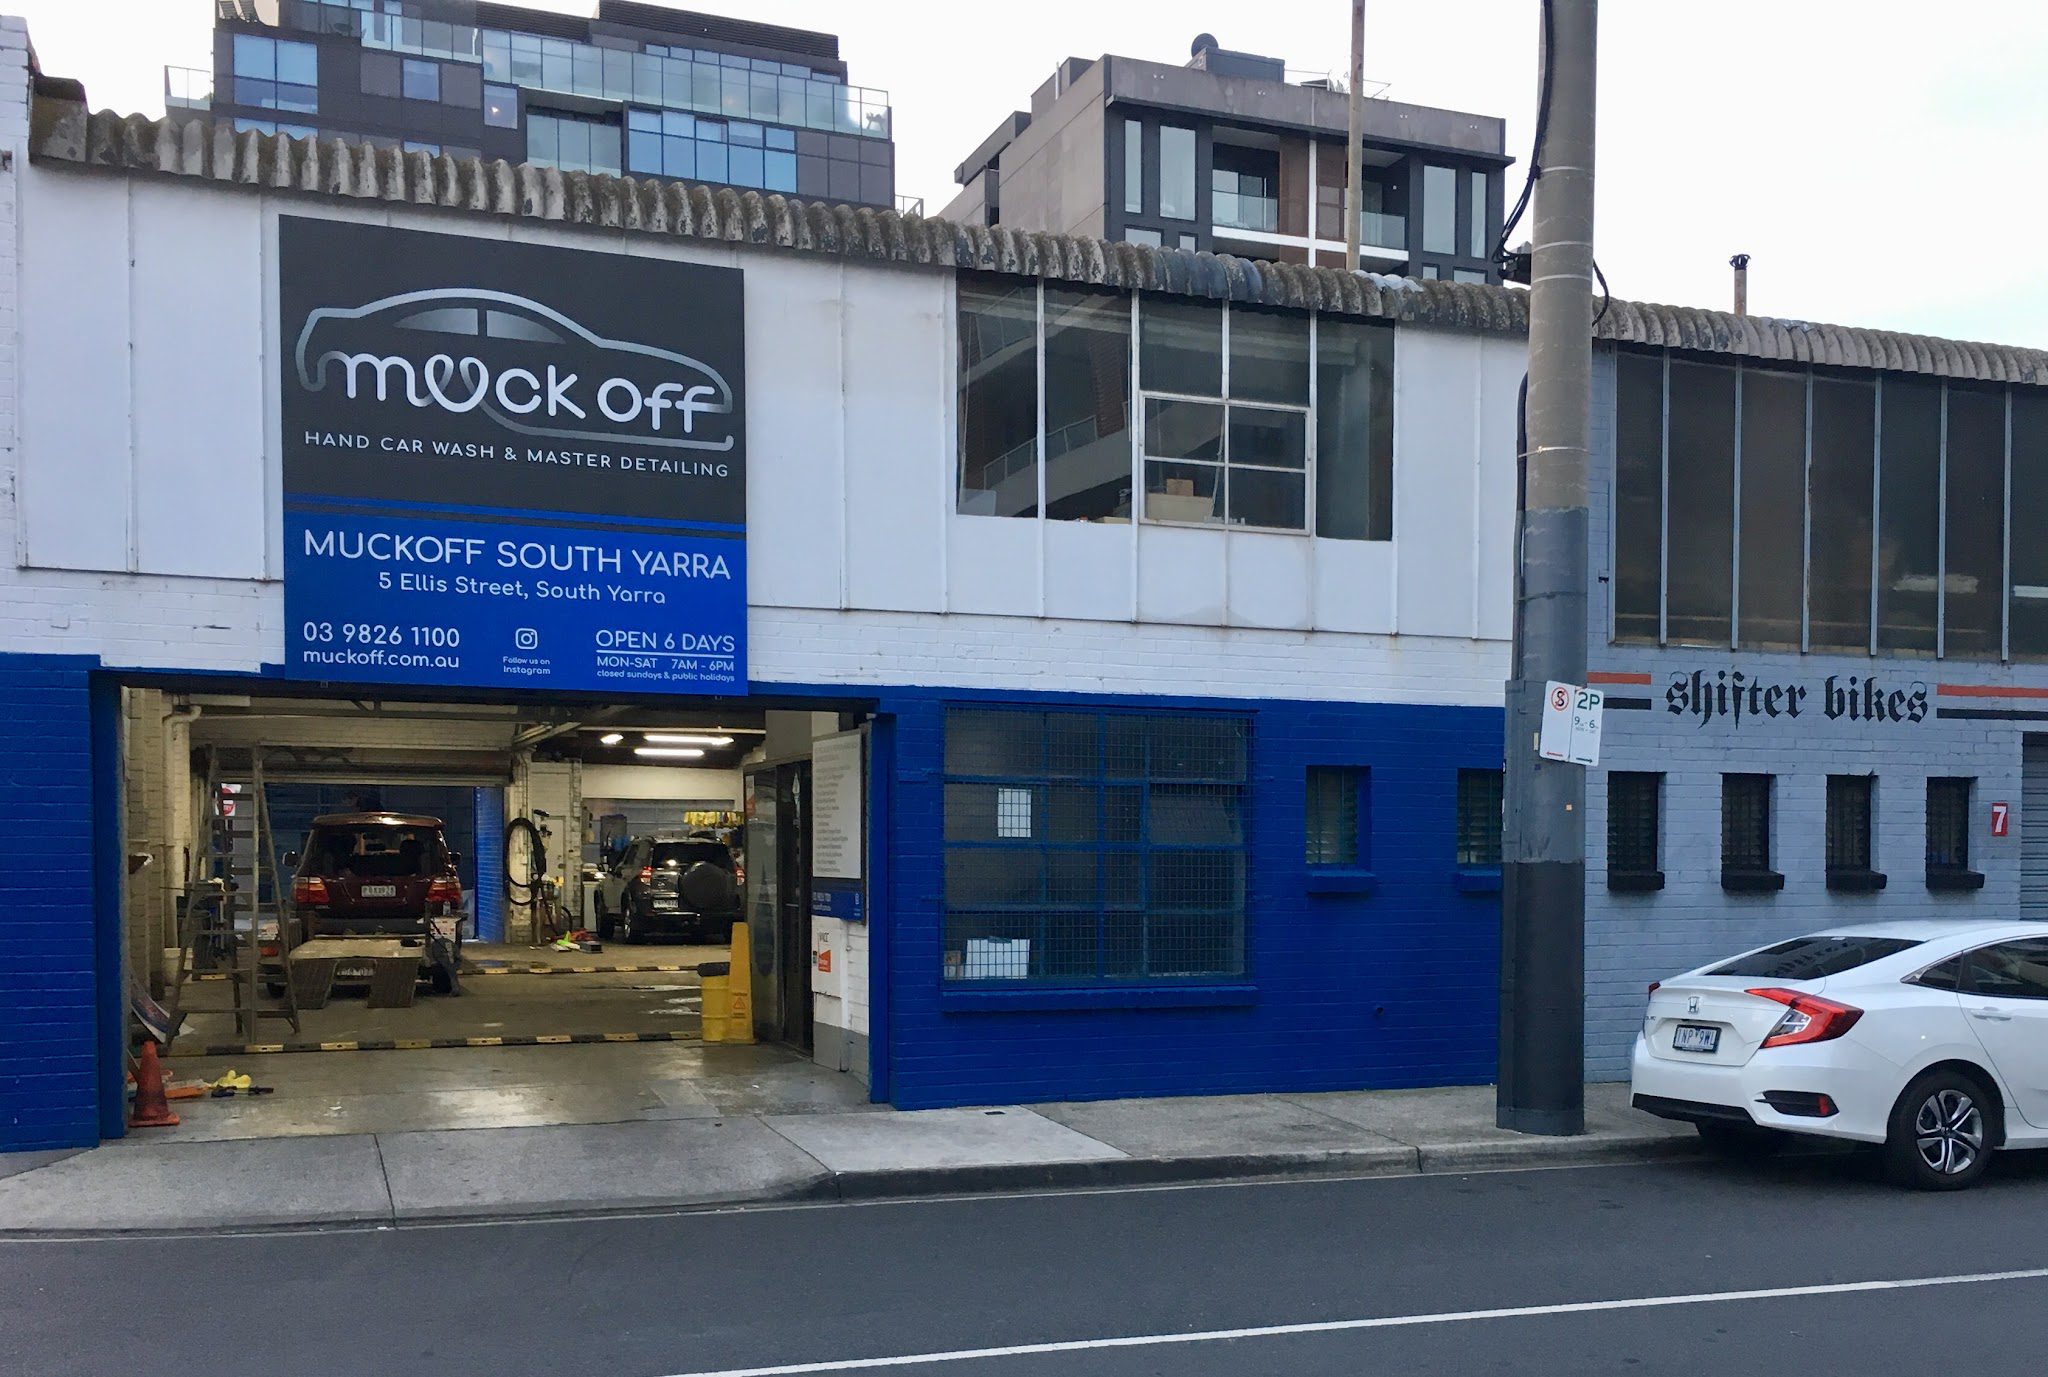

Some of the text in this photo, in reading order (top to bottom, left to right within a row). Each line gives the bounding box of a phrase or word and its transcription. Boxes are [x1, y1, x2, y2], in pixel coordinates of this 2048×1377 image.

[304, 430, 729, 478] HAND CAR WASH & MASTER DETAILING
[305, 529, 731, 580] MUCKOFF SOUTH YARRA
[379, 572, 666, 604] 5 Ellis Street, South Yarra
[303, 622, 460, 647] 03 9826 1100
[595, 630, 735, 652] OPEN 6 DAYS
[303, 649, 460, 668] muckoff.com.au
[503, 656, 528, 664] Follow
[597, 656, 658, 668] MON-SAT
[671, 659, 697, 670] 7AM
[709, 661, 734, 671] 6PM
[504, 666, 550, 675] Instagram
[597, 669, 735, 682] closed sundays & public holidays
[1577, 692, 1600, 710] 2P
[1824, 674, 1928, 724] bikes
[1993, 806, 2006, 833] 7
